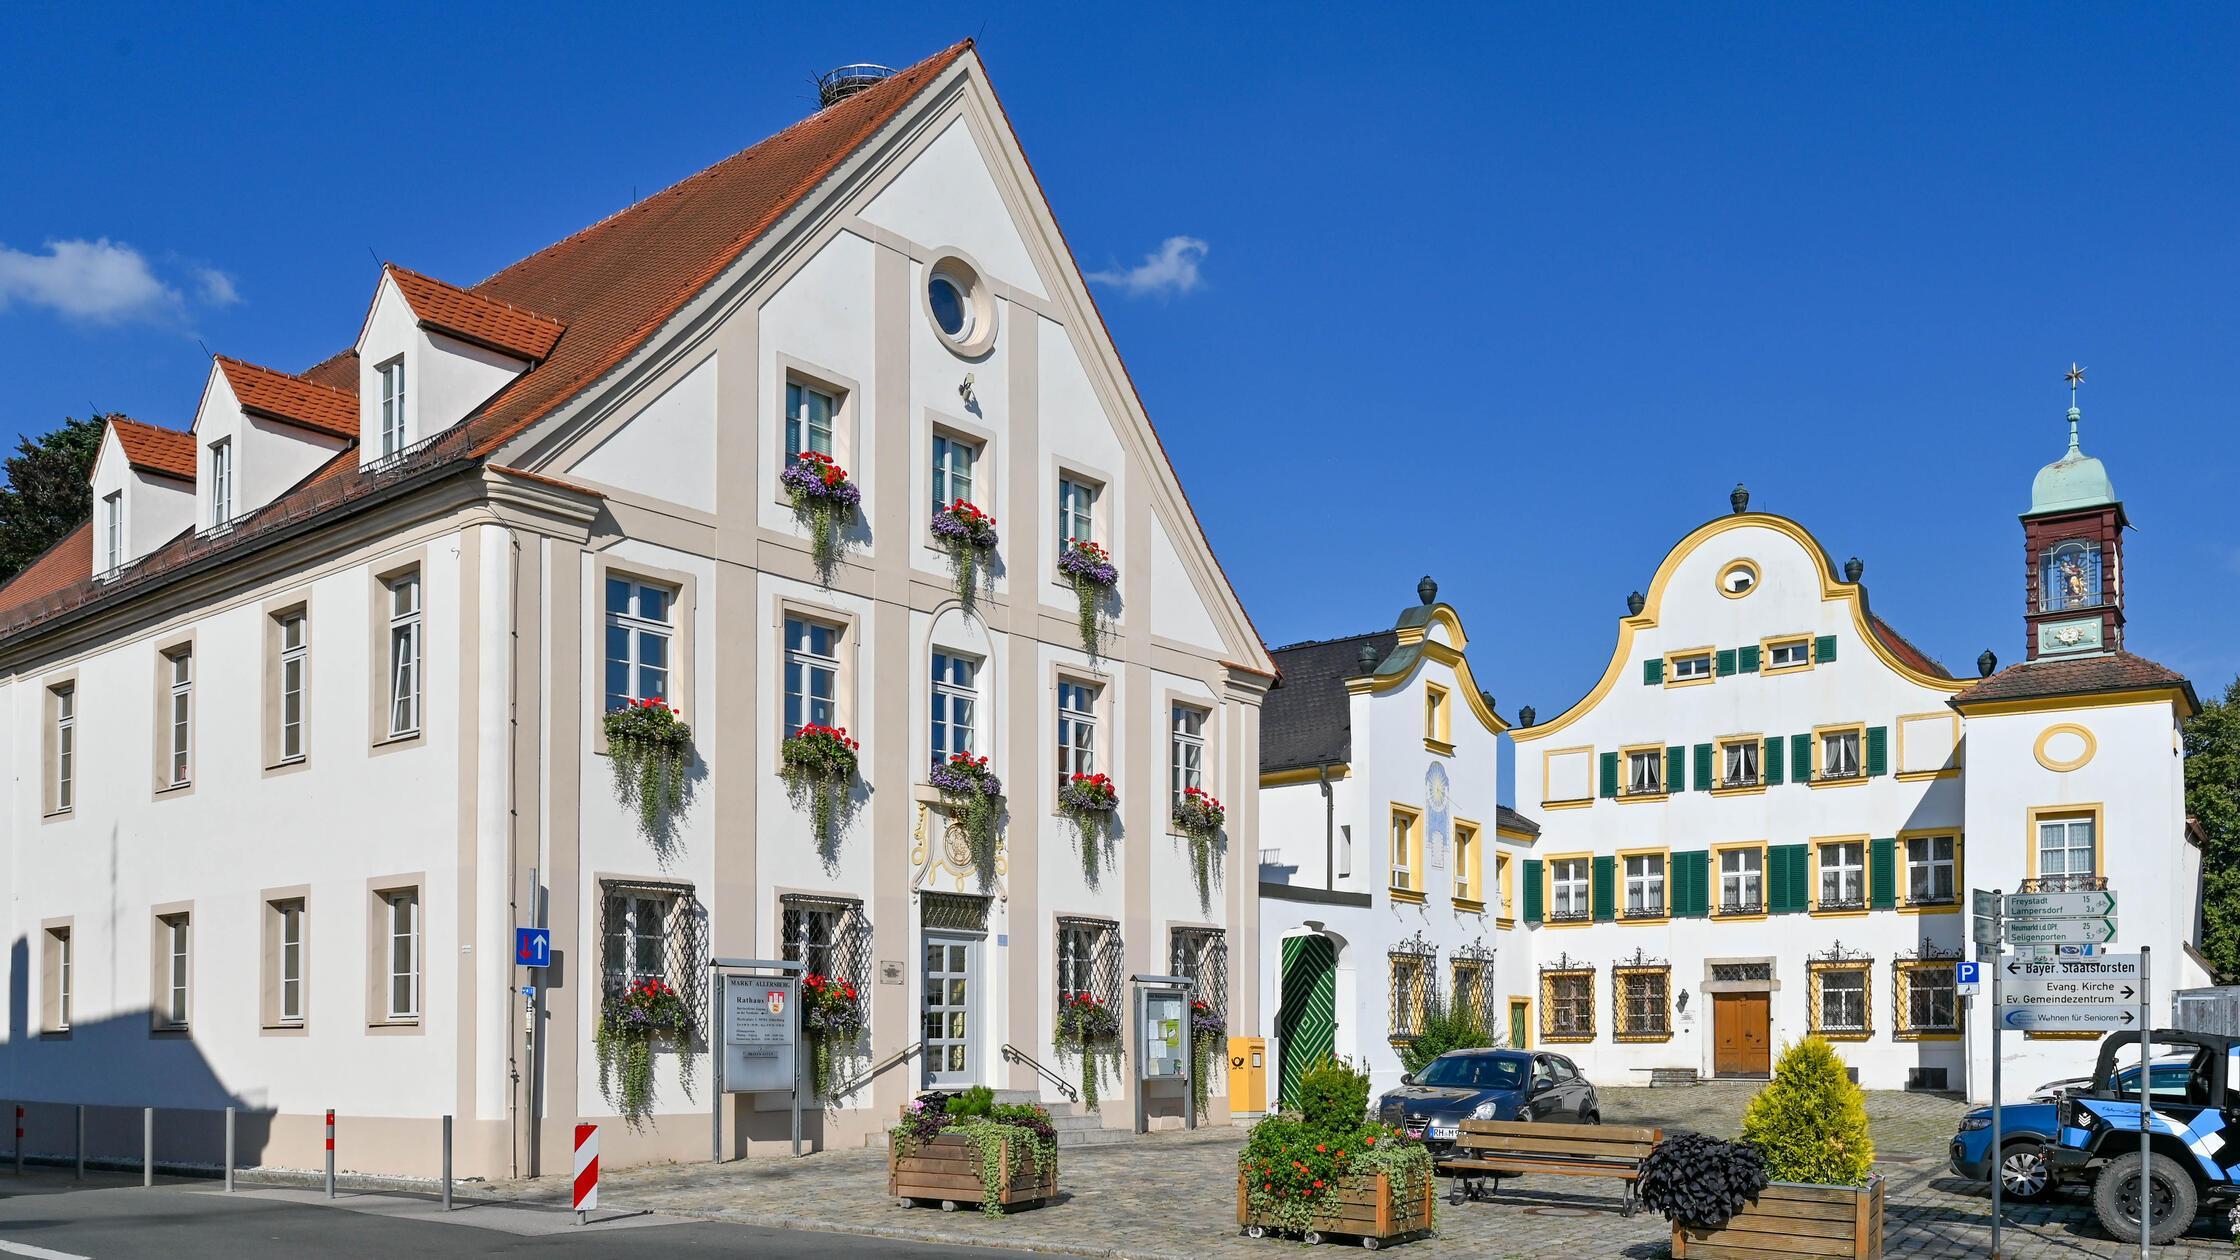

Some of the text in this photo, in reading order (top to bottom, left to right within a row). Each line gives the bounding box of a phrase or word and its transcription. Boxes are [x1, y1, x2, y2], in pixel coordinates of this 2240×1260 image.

[2011, 895, 2090, 906] Freystadt 15
[2011, 906, 2063, 915] Lampersdorf
[2011, 923, 2038, 931] Neumarkt
[2082, 922, 2091, 930] 25
[2011, 933, 2066, 942] Seligenporten
[1961, 964, 1974, 982] P
[2026, 962, 2135, 976] Bayer. Staatsforsten
[2047, 982, 2115, 992] Evang. Kirche
[736, 996, 765, 1004] Rathaus
[2006, 994, 2115, 1003] Ev. Gemeindezentrum
